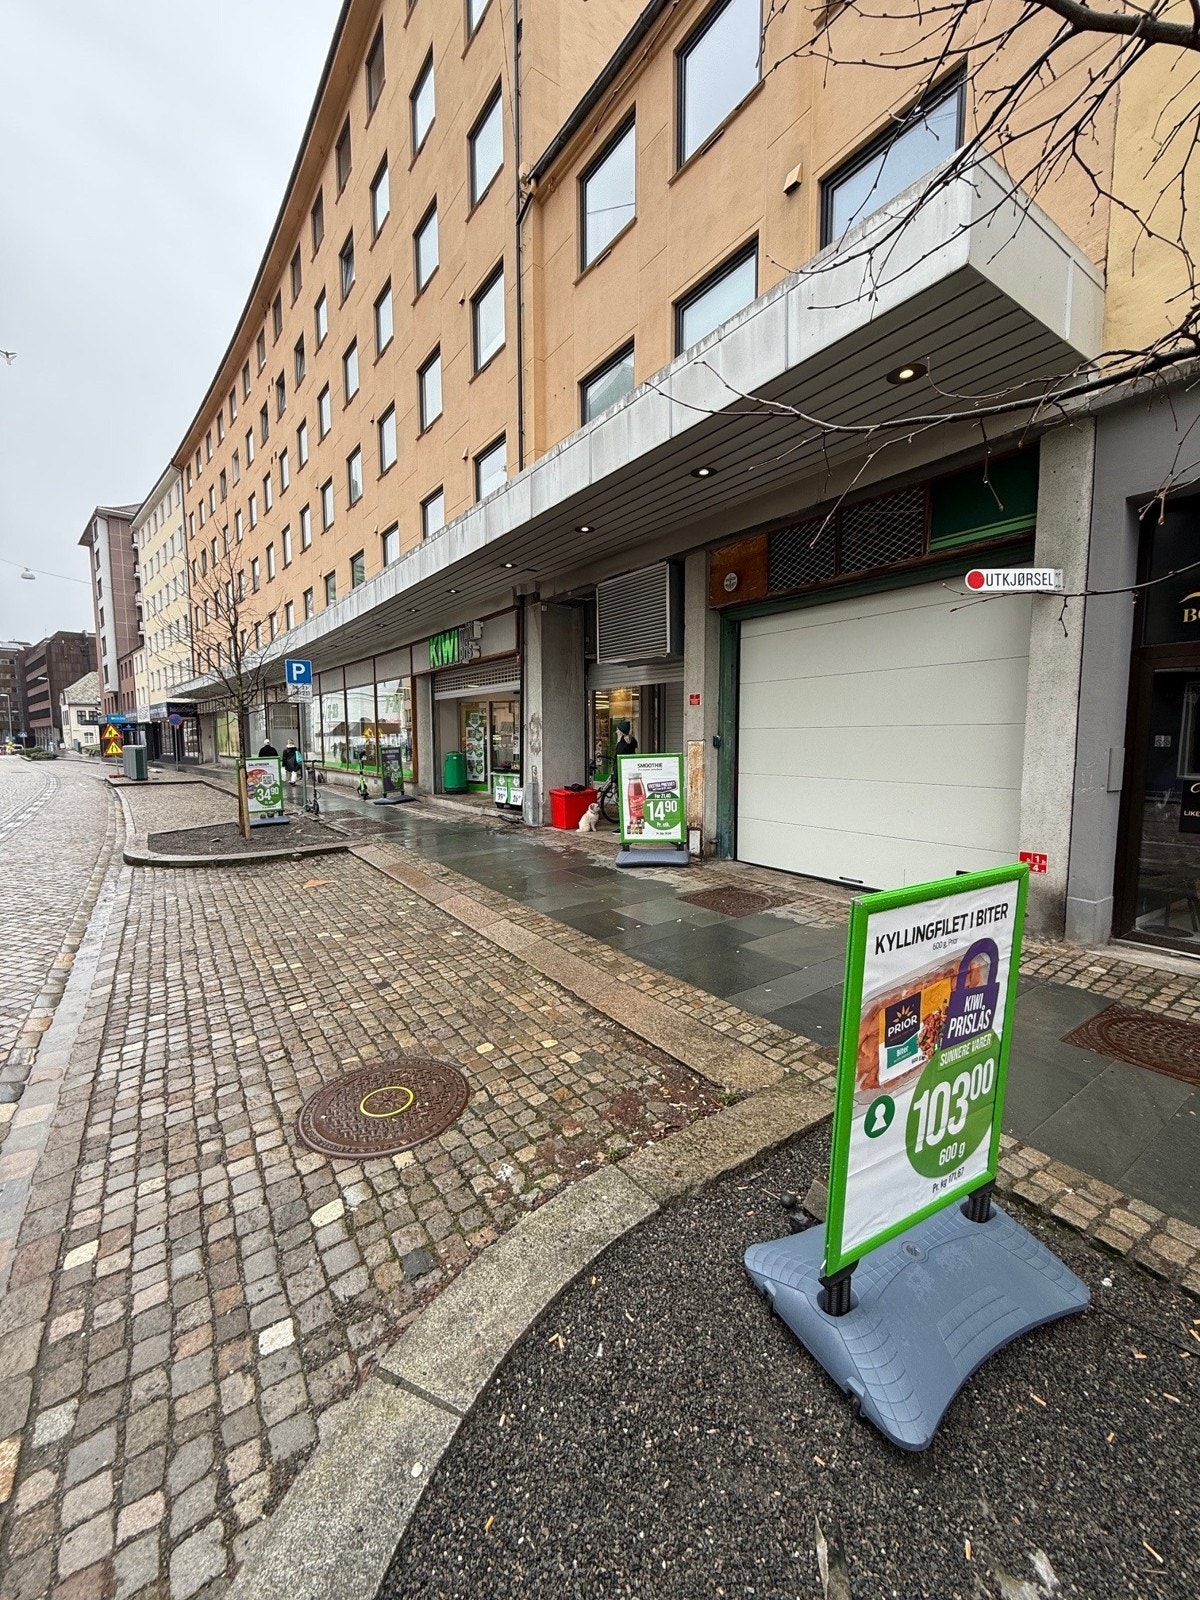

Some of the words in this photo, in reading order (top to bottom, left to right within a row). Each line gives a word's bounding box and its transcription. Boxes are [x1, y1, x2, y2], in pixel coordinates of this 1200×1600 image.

[985, 572, 1053, 587] UTKJØRSEL
[430, 629, 459, 669] KIWI
[292, 663, 306, 681] P
[875, 913, 969, 955] KYLLINGFILET
[969, 911, 974, 929] I
[976, 902, 1009, 927] BITER
[932, 941, 943, 951] 600
[948, 937, 959, 946] Prior
[887, 1014, 918, 1037] PRIOR
[947, 1004, 992, 1039] PRISLÅS
[940, 1042, 970, 1067] SUNNERE
[971, 1032, 993, 1052] VARER
[939, 1142, 957, 1166] 600
[958, 1142, 966, 1158] g
